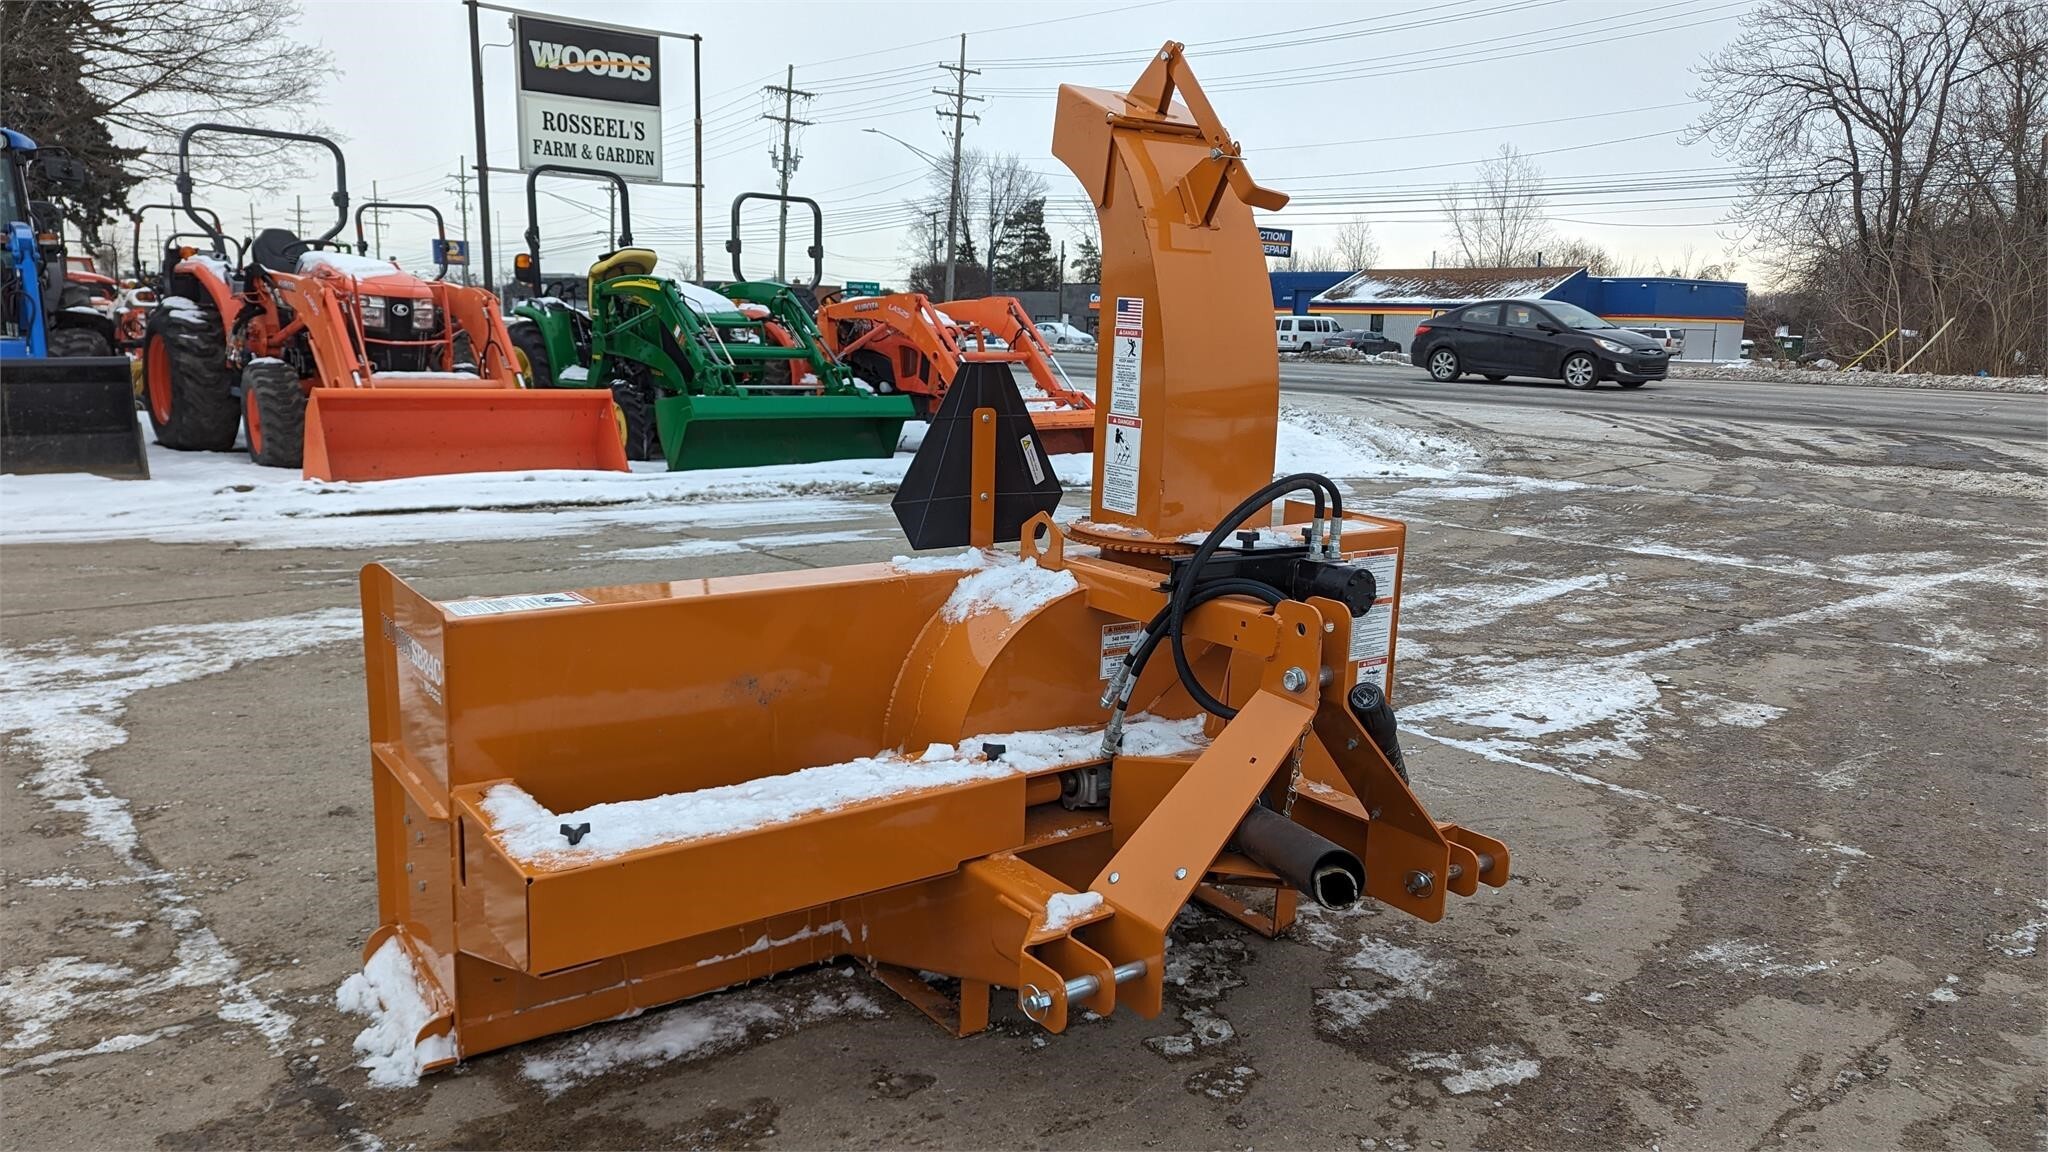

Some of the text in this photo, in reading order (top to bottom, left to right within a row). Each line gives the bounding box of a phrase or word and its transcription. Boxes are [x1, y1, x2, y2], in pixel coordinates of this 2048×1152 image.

[528, 39, 652, 82] WOODS
[542, 110, 646, 141] ROSSEEL'S
[533, 138, 655, 166] FARM & GARDEN
[1263, 244, 1289, 255] EPAIR
[1117, 417, 1136, 426] DANGER
